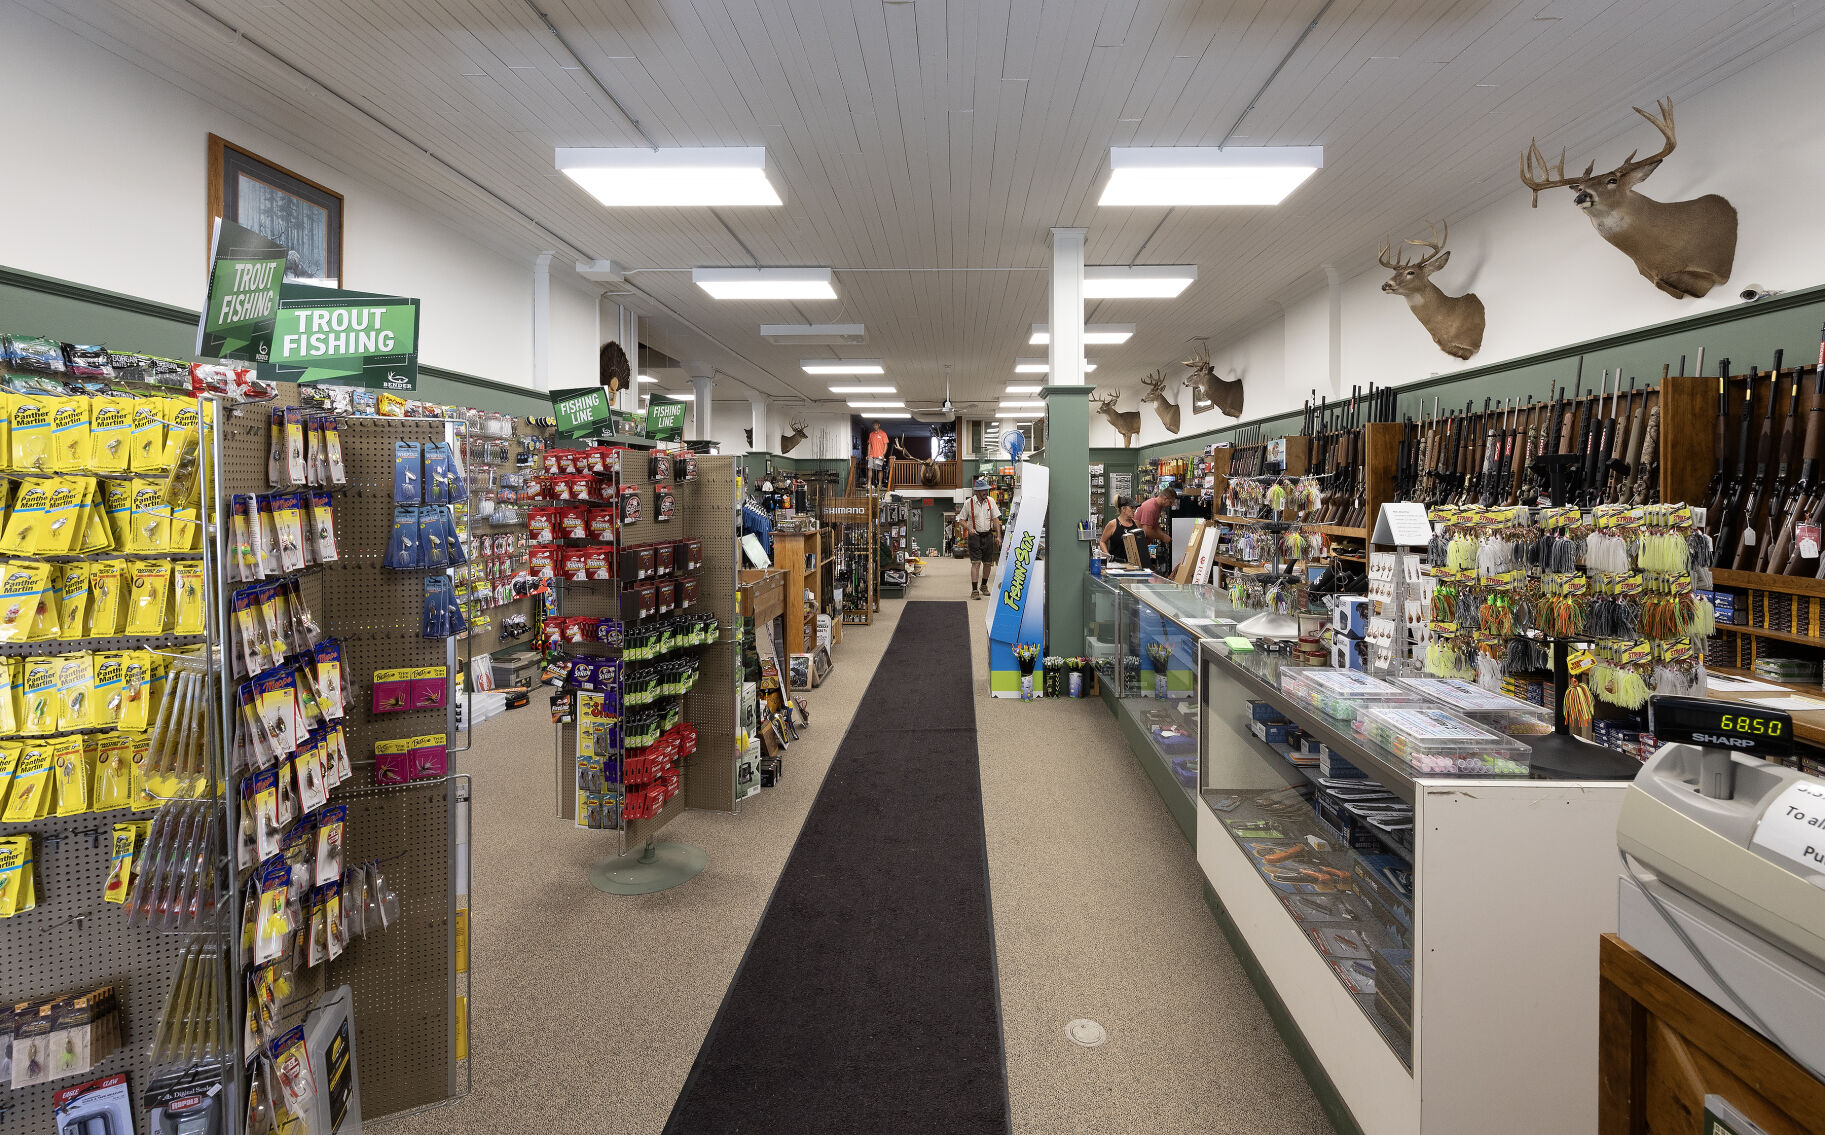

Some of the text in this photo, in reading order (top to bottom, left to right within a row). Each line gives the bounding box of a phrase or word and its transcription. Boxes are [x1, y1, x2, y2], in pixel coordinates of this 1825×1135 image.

[233, 262, 277, 292] TROUT
[219, 290, 274, 325] FISHING
[294, 308, 388, 333] TROUT
[282, 331, 396, 358] FISHING
[560, 393, 600, 416] FISHING
[14, 411, 49, 421] Panther
[571, 408, 594, 425] LINE
[653, 405, 682, 418] FISHING
[16, 418, 46, 427] Martin
[53, 411, 84, 424] Panther
[95, 413, 127, 423] Panther
[658, 416, 674, 428] LINE
[55, 417, 82, 429] Martin
[97, 420, 125, 428] Martin
[20, 495, 47, 503] Panthe
[49, 494, 77, 504] Panther
[133, 495, 162, 505] Panthe
[50, 500, 73, 509] Martin
[824, 507, 865, 515] SHIMANO
[1478, 515, 1498, 524] STRIKE
[1673, 514, 1687, 522] STRIKE
[3, 579, 40, 588] Panther
[1485, 577, 1505, 585] STRIKE
[1620, 582, 1638, 590] STRIKE
[1674, 581, 1688, 589] STRIKE
[3, 586, 34, 594] Martin
[1627, 651, 1646, 660] STRIKE
[1670, 647, 1688, 657] STRIKE
[26, 672, 56, 685] Panther
[28, 680, 53, 690] Martin
[1720, 714, 1783, 736] 68.50
[1692, 733, 1756, 748] SHARP
[20, 755, 48, 768] Panther
[20, 763, 43, 774] Martin
[1786, 805, 1806, 821] To
[102, 1077, 119, 1087] CLAW
